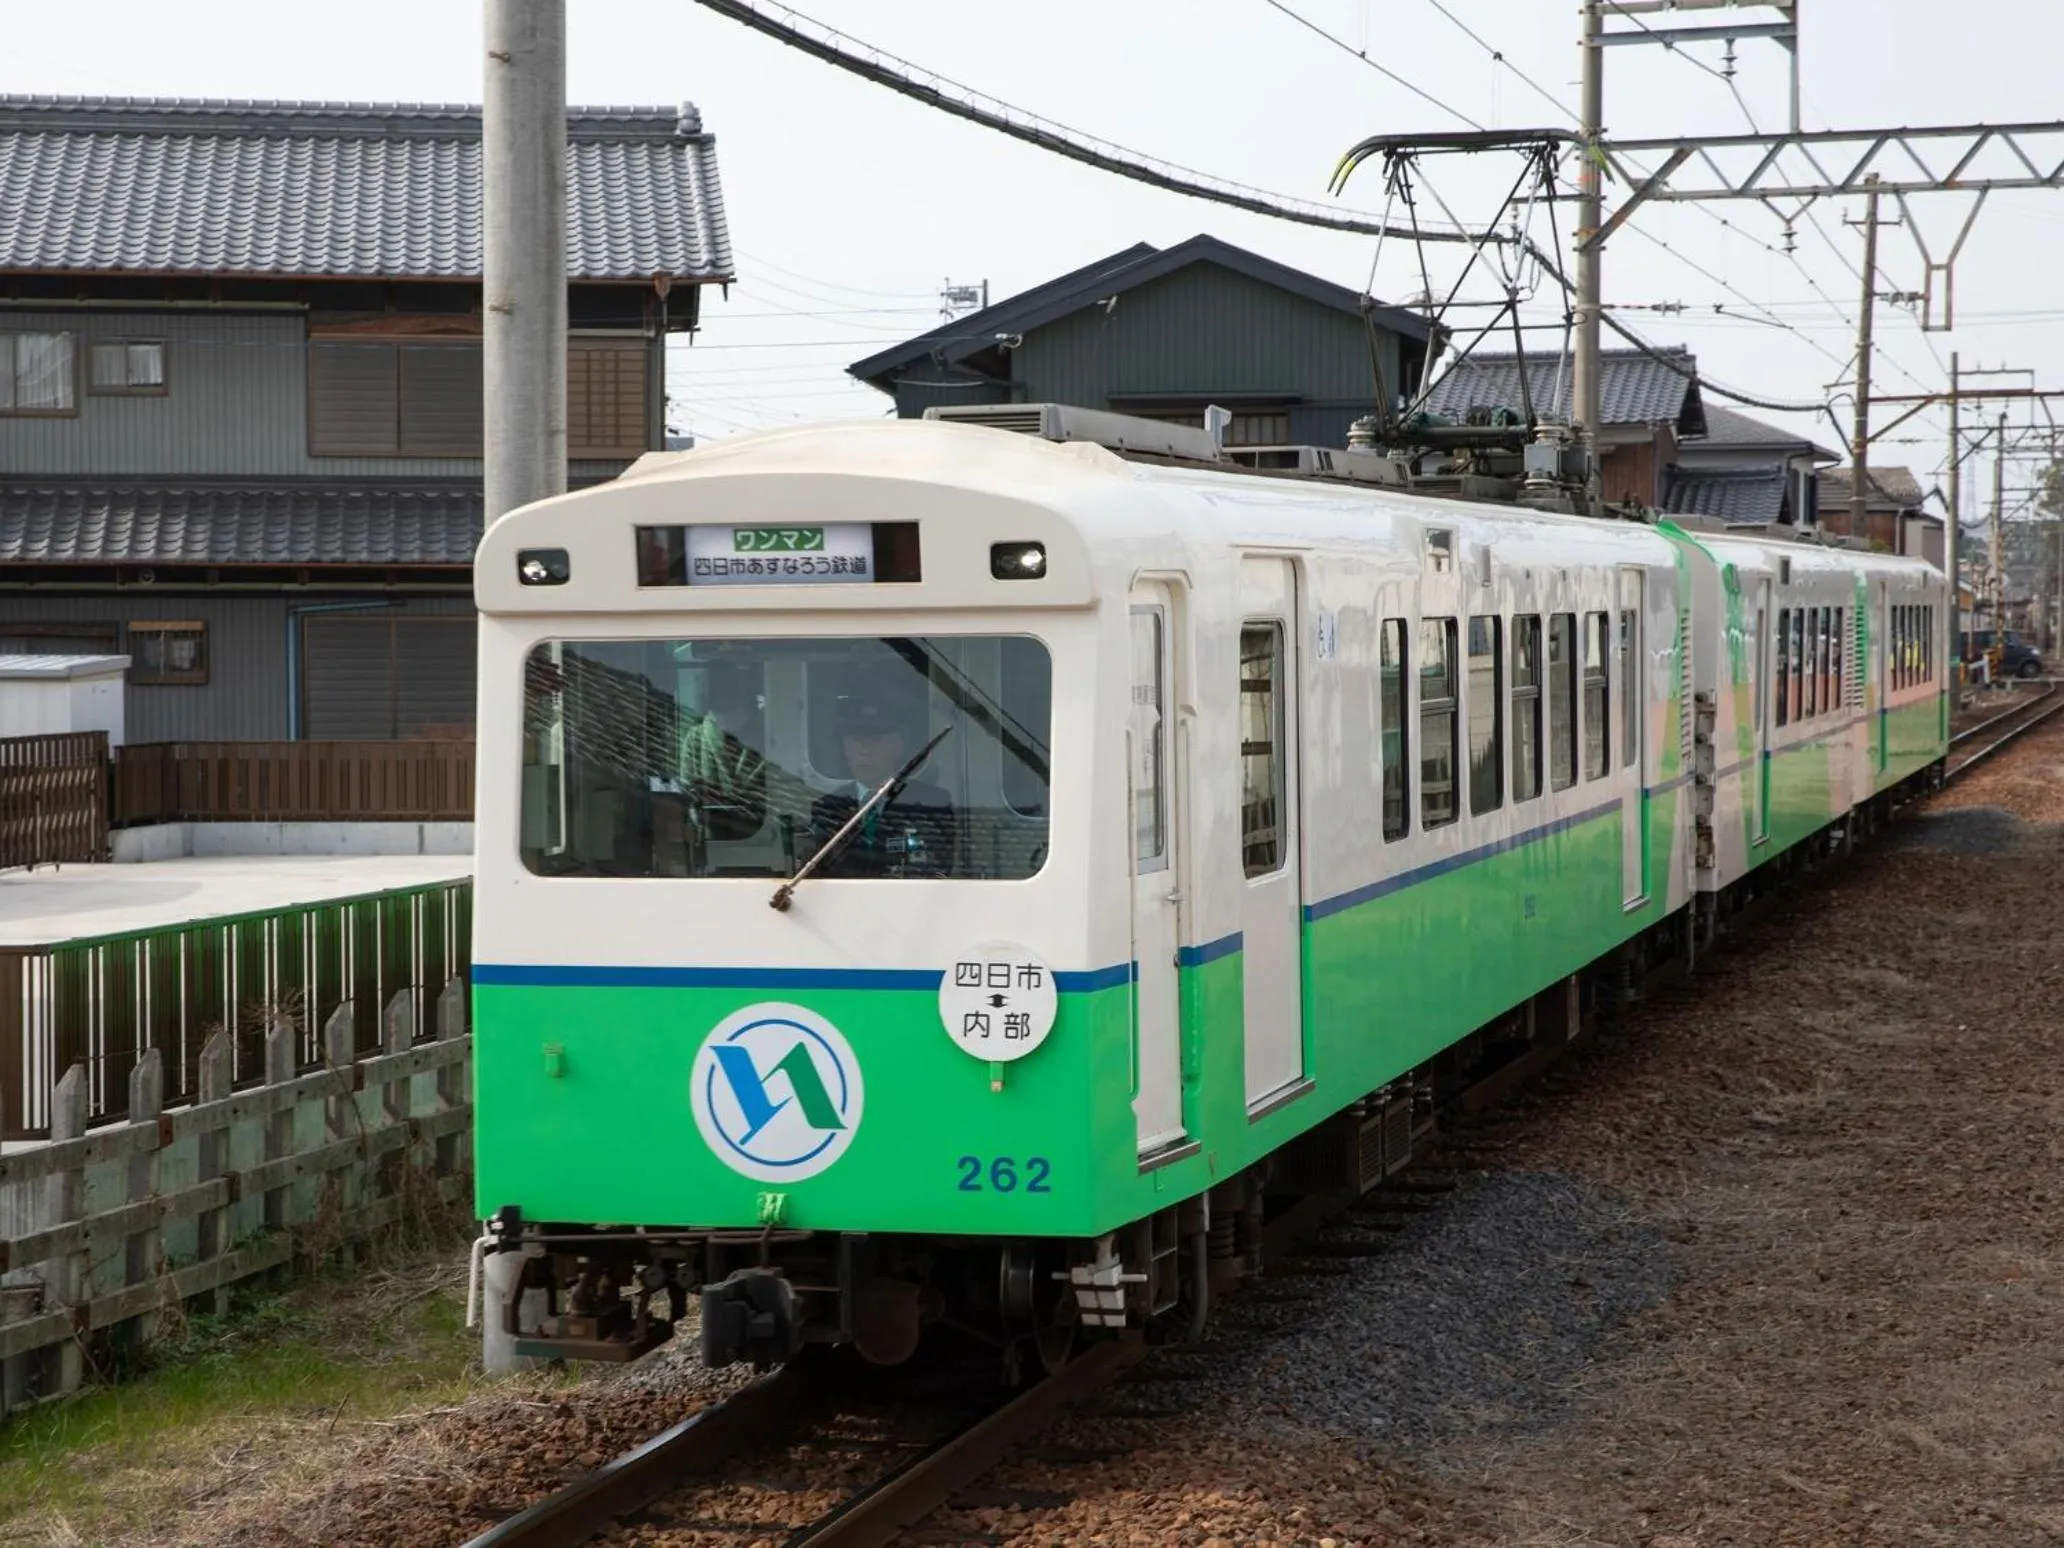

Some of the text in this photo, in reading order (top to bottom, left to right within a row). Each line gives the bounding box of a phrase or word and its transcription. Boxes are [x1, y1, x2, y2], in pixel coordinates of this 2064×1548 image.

[736, 530, 822, 550] ワンマン
[694, 556, 867, 576] 四日市あすなろう鉄道
[955, 962, 1044, 990] 四日市
[963, 1010, 1030, 1040] 内部
[957, 1156, 1051, 1193] 262
